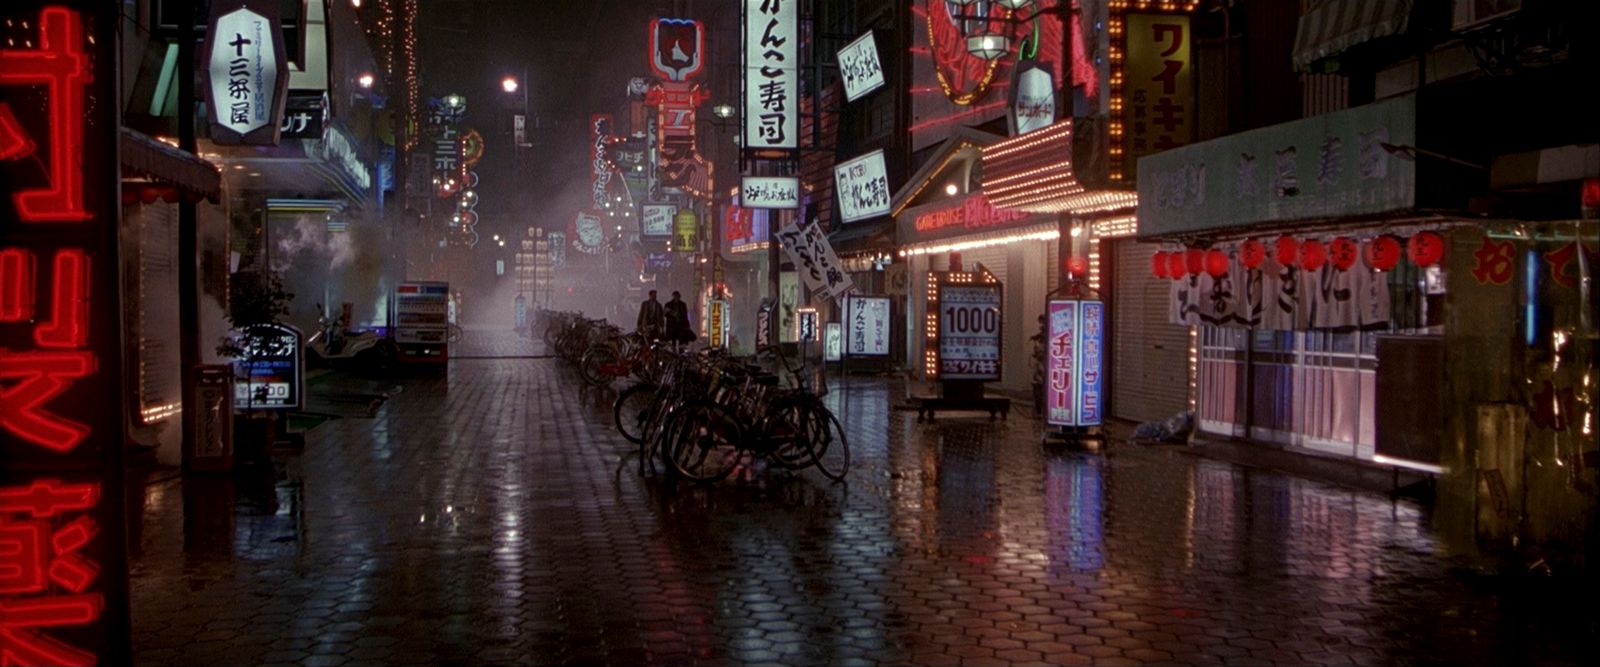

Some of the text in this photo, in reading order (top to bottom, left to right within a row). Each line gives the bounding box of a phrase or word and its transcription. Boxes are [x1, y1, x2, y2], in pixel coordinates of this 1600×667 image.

[945, 303, 995, 329] 1000
[1051, 332, 1071, 408] チェリー
